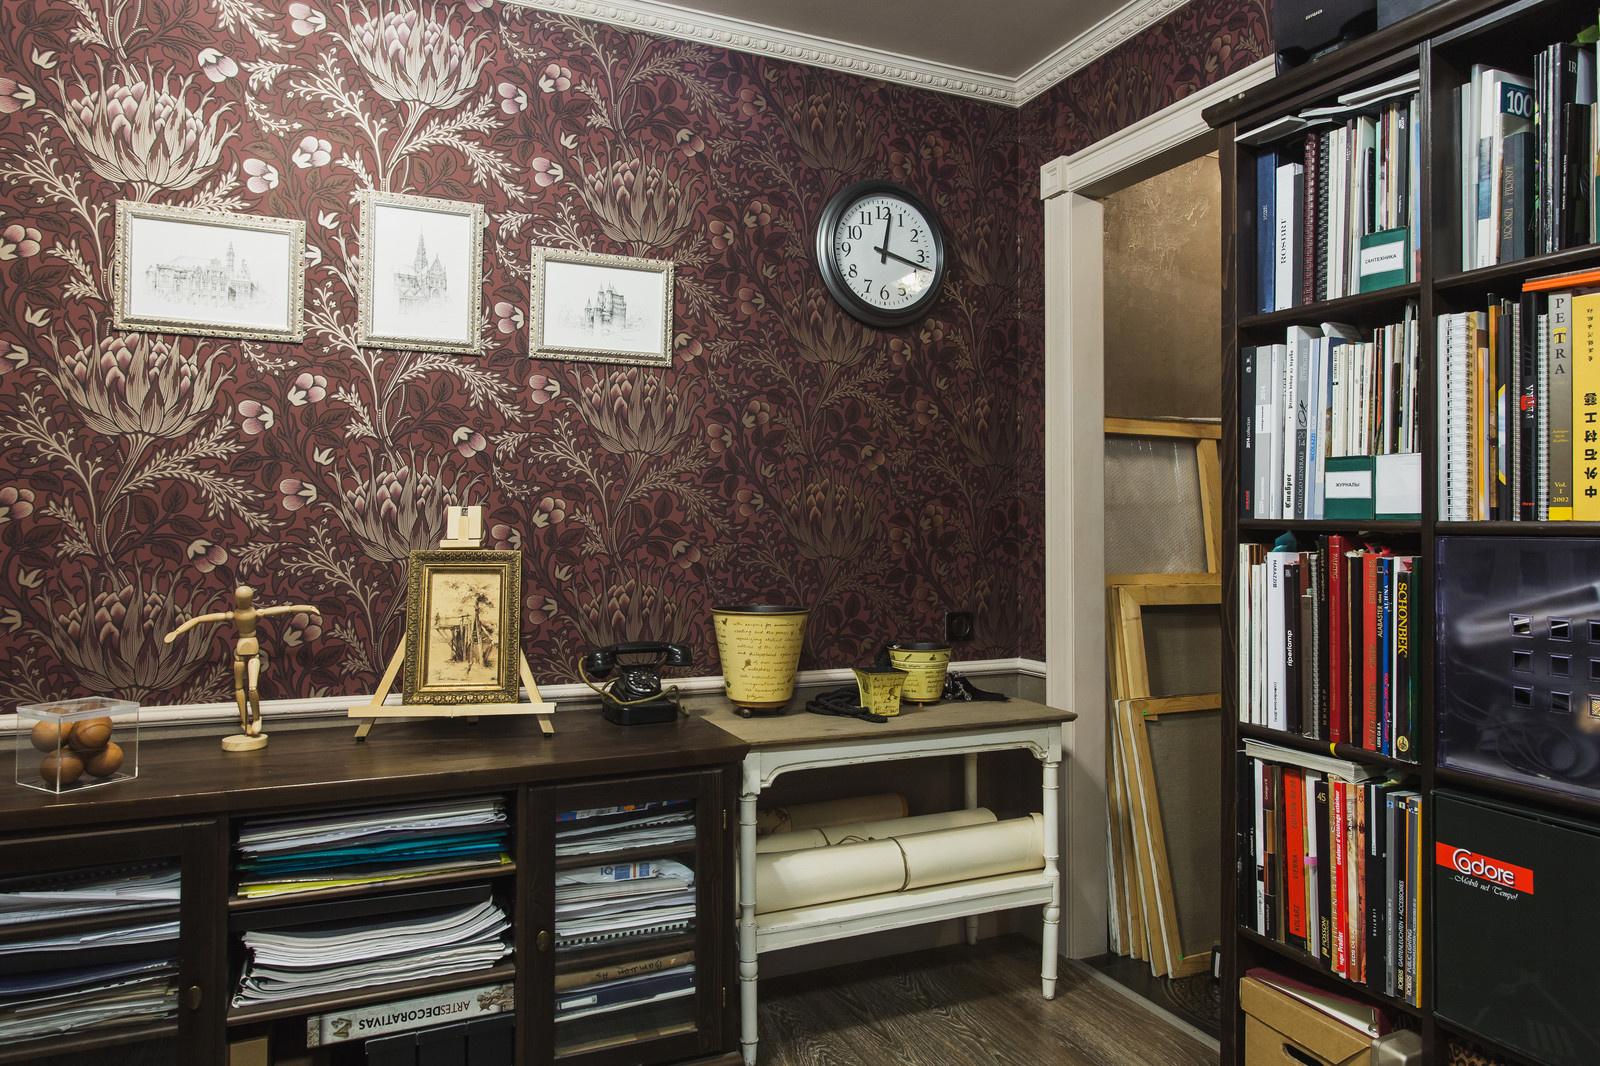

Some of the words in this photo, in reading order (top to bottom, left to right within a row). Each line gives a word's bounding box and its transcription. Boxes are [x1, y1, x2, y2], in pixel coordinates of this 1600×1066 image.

[1506, 89, 1534, 118] 100
[860, 211, 873, 225] 11
[875, 206, 891, 220] 12
[898, 214, 904, 227] 1
[847, 226, 862, 240] 10
[910, 229, 918, 243] 2
[841, 242, 851, 257] 9
[916, 250, 925, 263] 3
[1364, 253, 1397, 265] САНТЕХНИКА
[848, 264, 858, 278] 8
[864, 280, 872, 293] 7
[880, 285, 890, 300] 6
[1553, 297, 1567, 375] PETRA
[1368, 579, 1376, 604] EDITION
[1376, 605, 1384, 638] ALABASTER
[1398, 582, 1407, 655] SCHONBEK
[1317, 792, 1326, 802] 45
[1290, 802, 1298, 829] EDITION
[601, 867, 613, 876] IQ
[1453, 848, 1515, 886] Cadore
[1492, 886, 1518, 900] Tempo!
[358, 1000, 471, 1030] ARTESDECORATIVAS
